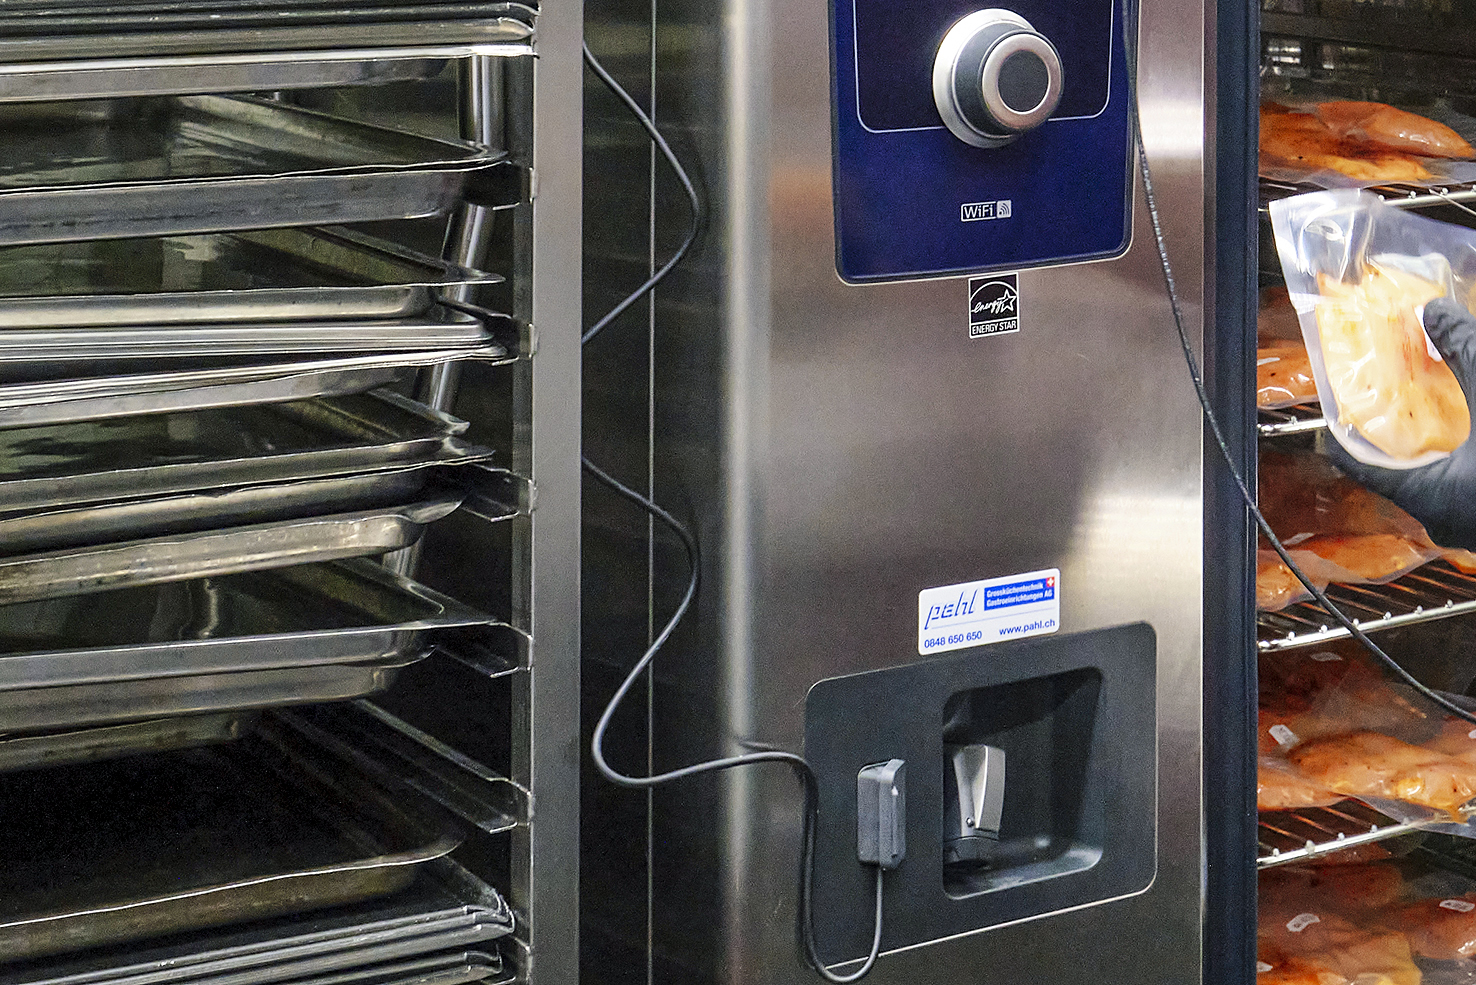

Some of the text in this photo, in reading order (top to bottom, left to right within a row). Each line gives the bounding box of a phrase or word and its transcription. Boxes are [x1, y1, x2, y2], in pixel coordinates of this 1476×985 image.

[964, 204, 994, 219] WiFi
[972, 320, 1017, 335] ENERGY STAR
[986, 582, 1044, 599] Grossküchentechnik
[986, 589, 1053, 608] Gastroeinrichtungen AG
[999, 618, 1056, 636] www.pahl.ch
[924, 630, 983, 649] 0848 650 650
